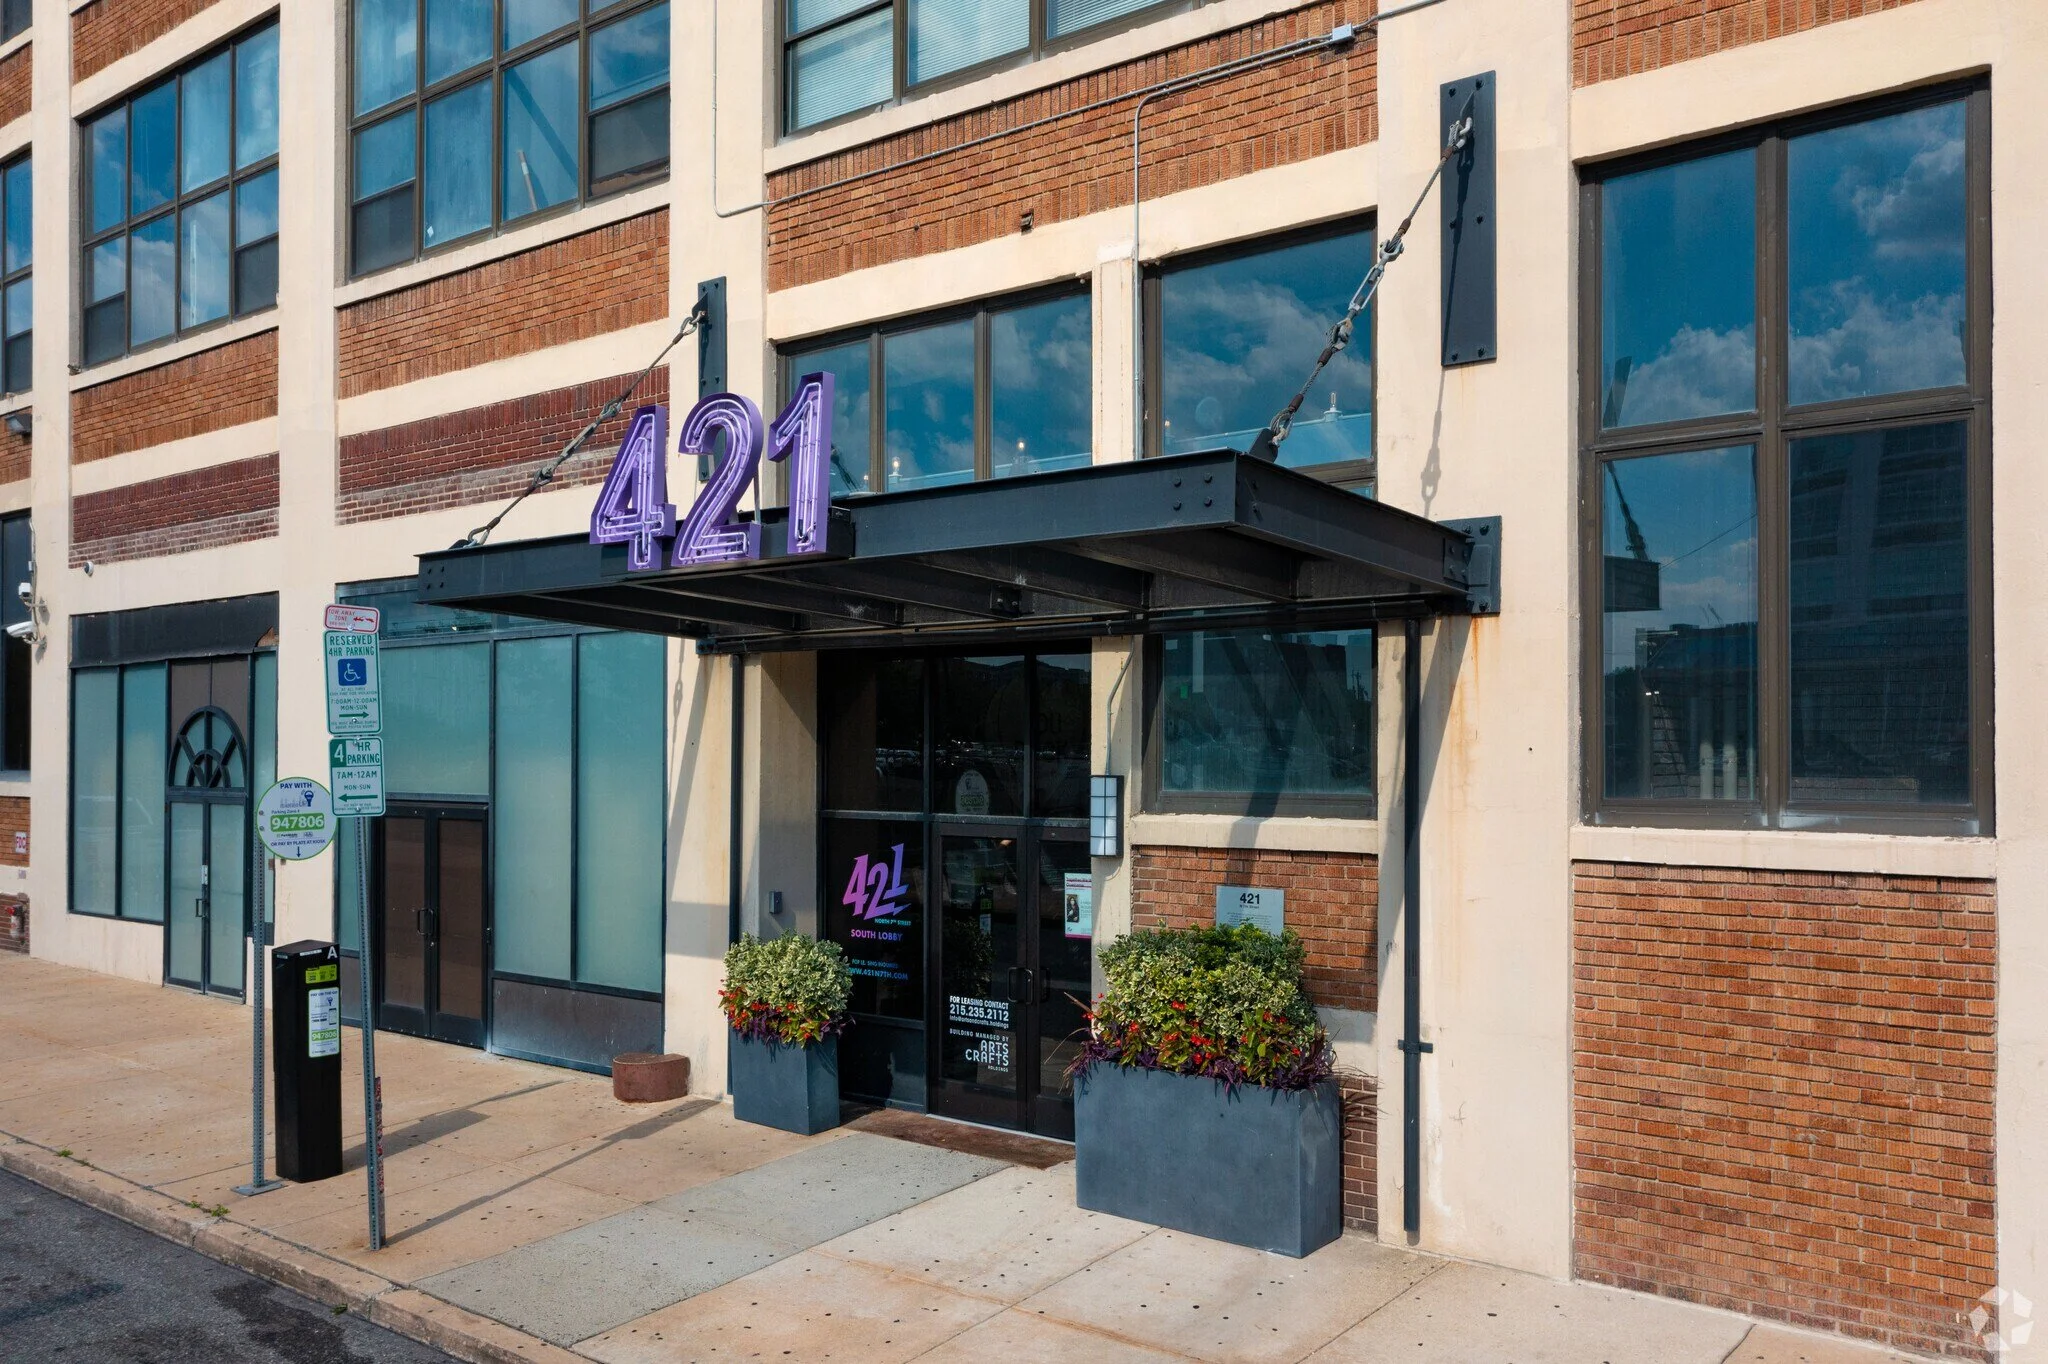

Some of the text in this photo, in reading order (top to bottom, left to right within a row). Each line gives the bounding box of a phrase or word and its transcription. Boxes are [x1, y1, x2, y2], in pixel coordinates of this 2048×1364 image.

[590, 371, 835, 571] 421
[330, 635, 372, 646] RESERVED
[329, 646, 374, 656] 4HR PARKING
[334, 741, 371, 763] 4 HR
[347, 753, 380, 764] PARKING
[337, 770, 377, 779] 7AM-12AM
[271, 815, 324, 830] 947806
[842, 843, 912, 920] 421
[1240, 893, 1260, 904] 421
[851, 929, 903, 941] SOUTH LOBBY
[327, 946, 337, 959] A
[950, 995, 1009, 1010] FOR LEASING CONTACT
[950, 1004, 1009, 1021] 215.235.2112
[950, 1028, 973, 1037] BUILDING
[976, 1032, 1000, 1041] MANAGED
[981, 1040, 1009, 1055] ARTS
[965, 1049, 1009, 1067] CRAFTS
[988, 1065, 1008, 1073] HOLDINGS
